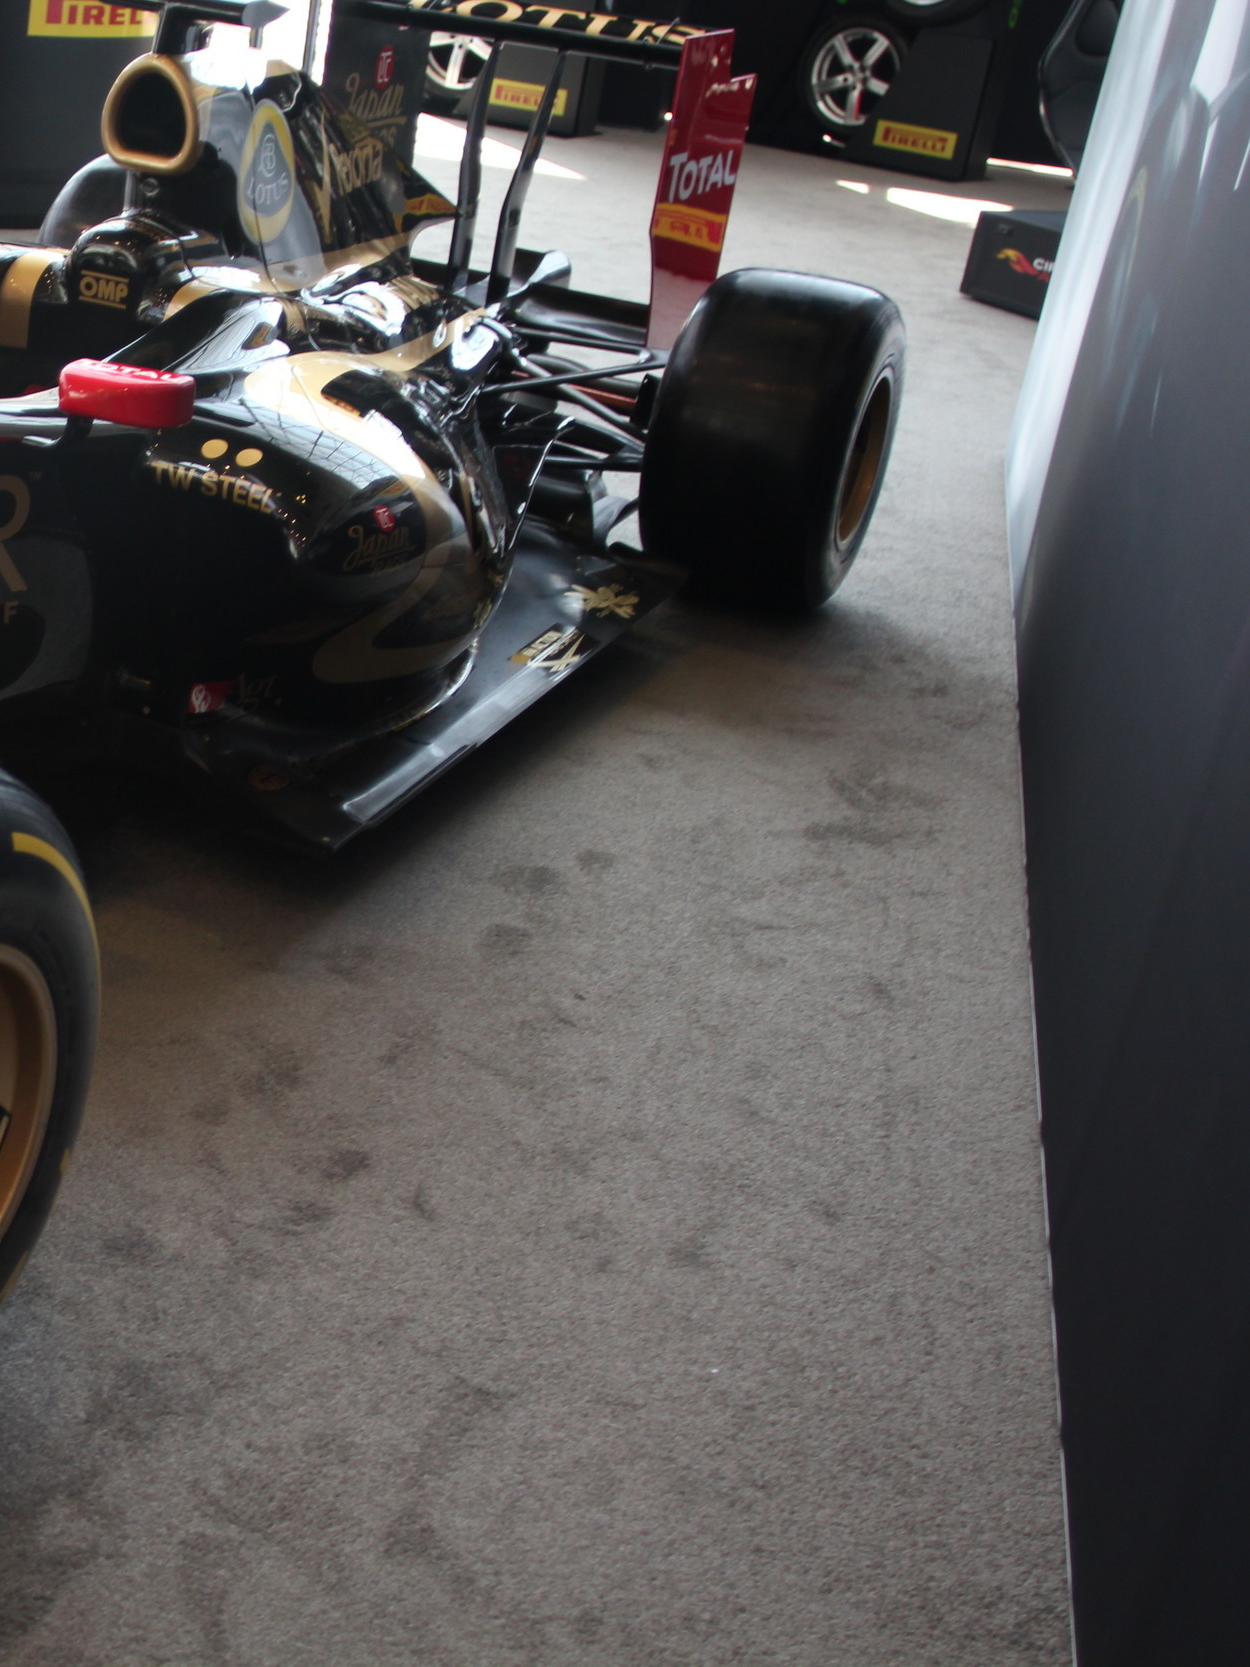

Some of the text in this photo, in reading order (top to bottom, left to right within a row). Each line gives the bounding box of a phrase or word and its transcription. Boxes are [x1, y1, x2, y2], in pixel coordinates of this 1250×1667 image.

[882, 126, 948, 153] PIRELLI
[246, 172, 289, 205] LOTUS
[668, 149, 738, 204] TOTAL
[79, 276, 129, 303] OMP
[149, 460, 275, 515] TW STEEL
